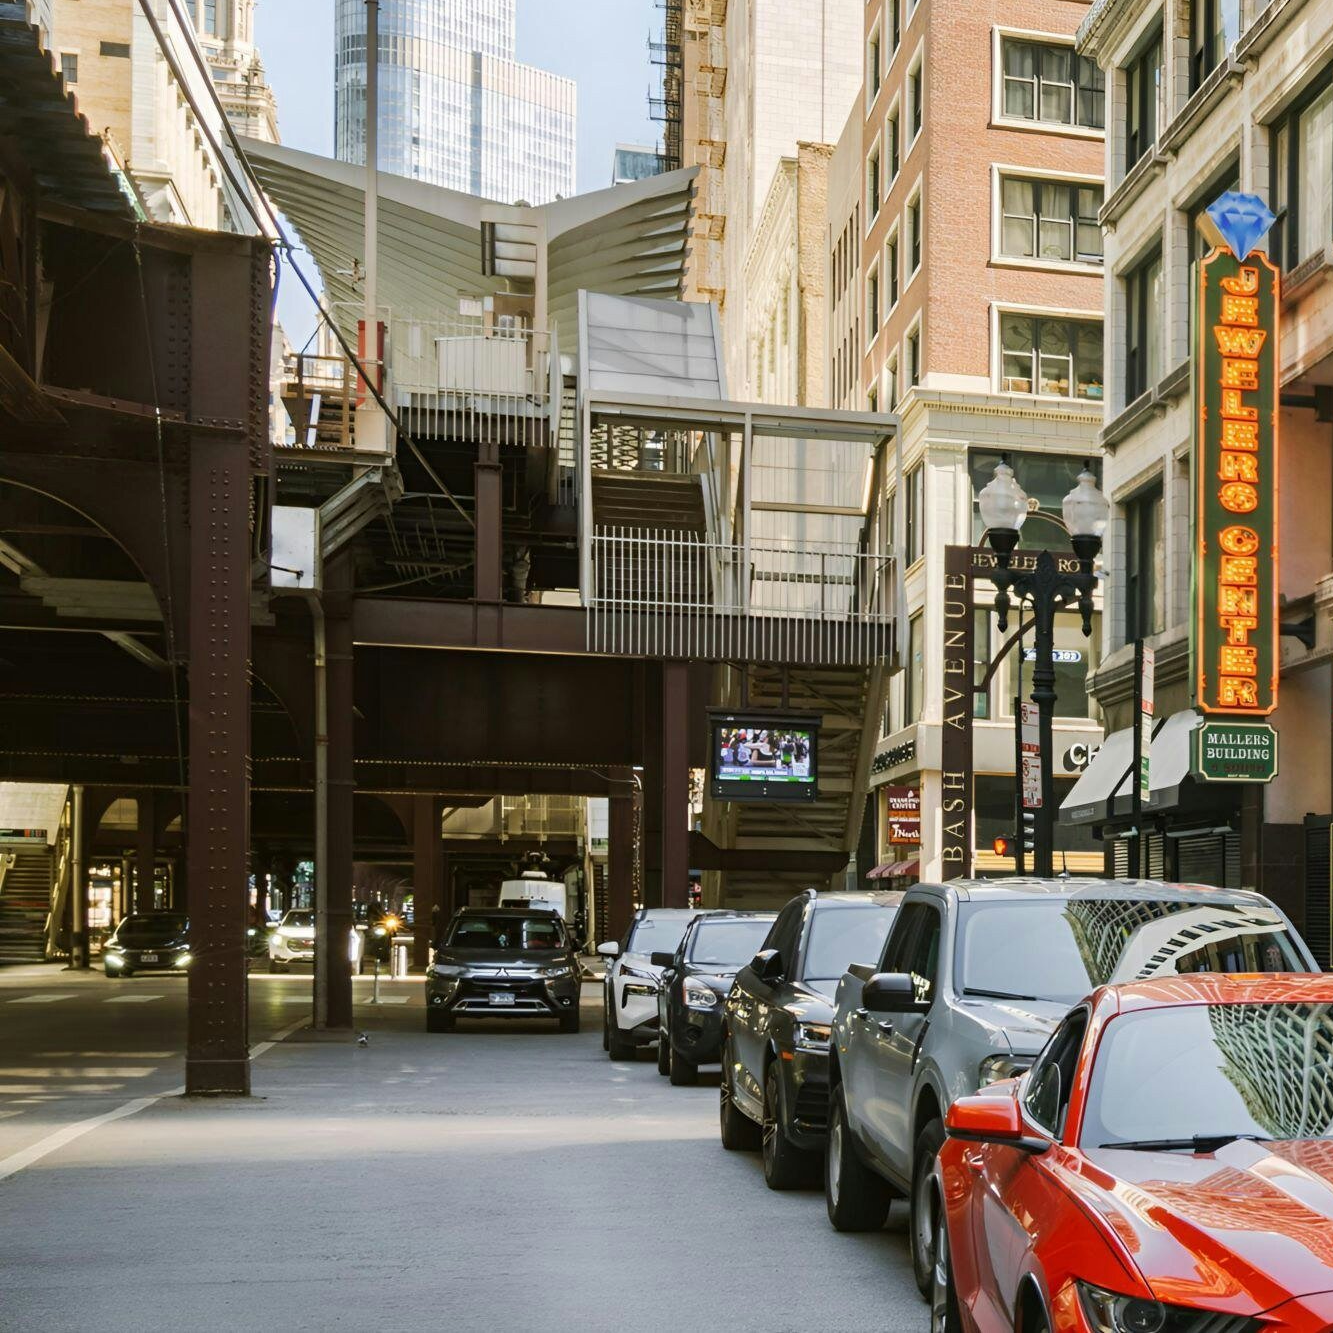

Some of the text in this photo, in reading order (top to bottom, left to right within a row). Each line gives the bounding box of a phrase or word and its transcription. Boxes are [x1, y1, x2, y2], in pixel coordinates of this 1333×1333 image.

[1212, 267, 1267, 514] JEWELERS
[1058, 558, 1081, 573] RO
[1217, 524, 1261, 709] CENTER
[942, 573, 967, 882] BASH AVENUE
[1206, 747, 1270, 760] BUILDING
[1207, 733, 1270, 746] MALLERS
